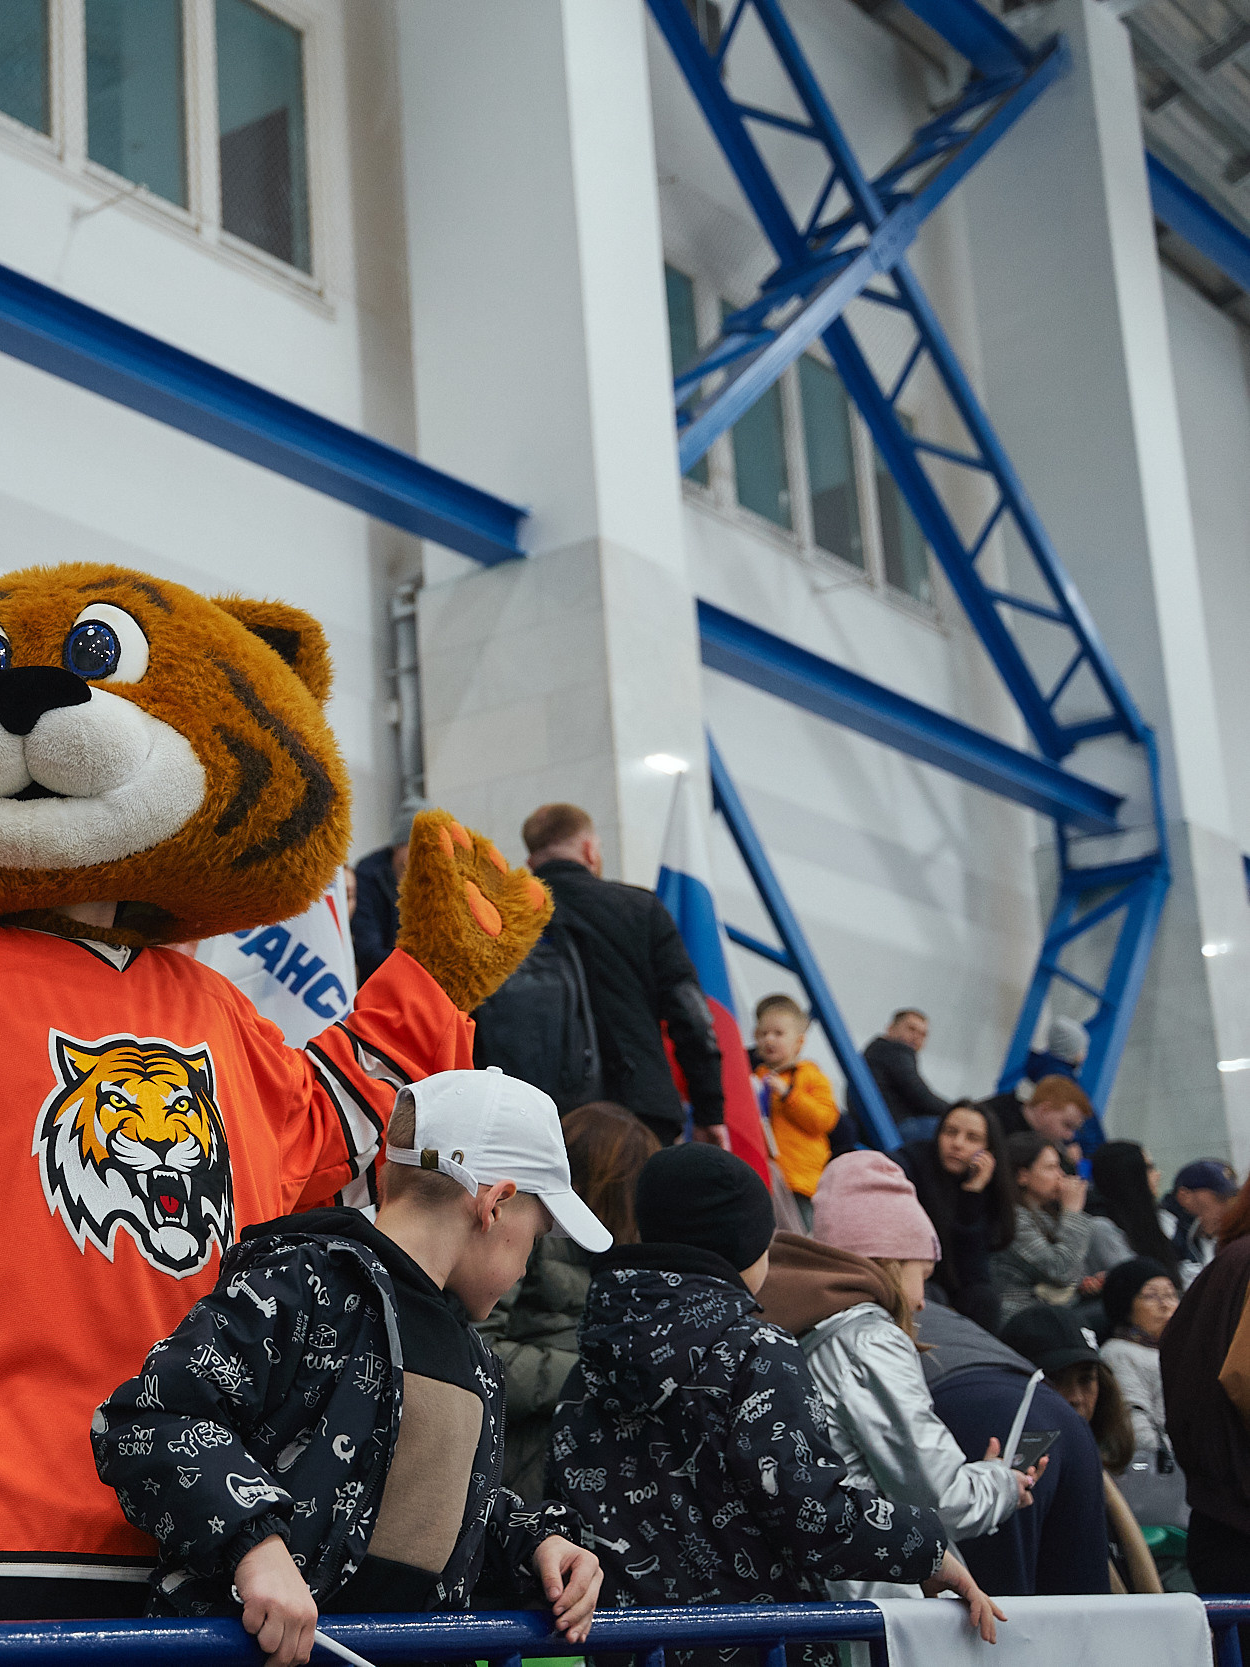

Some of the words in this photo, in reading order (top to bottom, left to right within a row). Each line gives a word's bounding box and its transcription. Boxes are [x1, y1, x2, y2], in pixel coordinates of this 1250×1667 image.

[231, 924, 350, 1022] АНС
[118, 1441, 154, 1456] SORRY
[564, 1468, 607, 1492] YES
